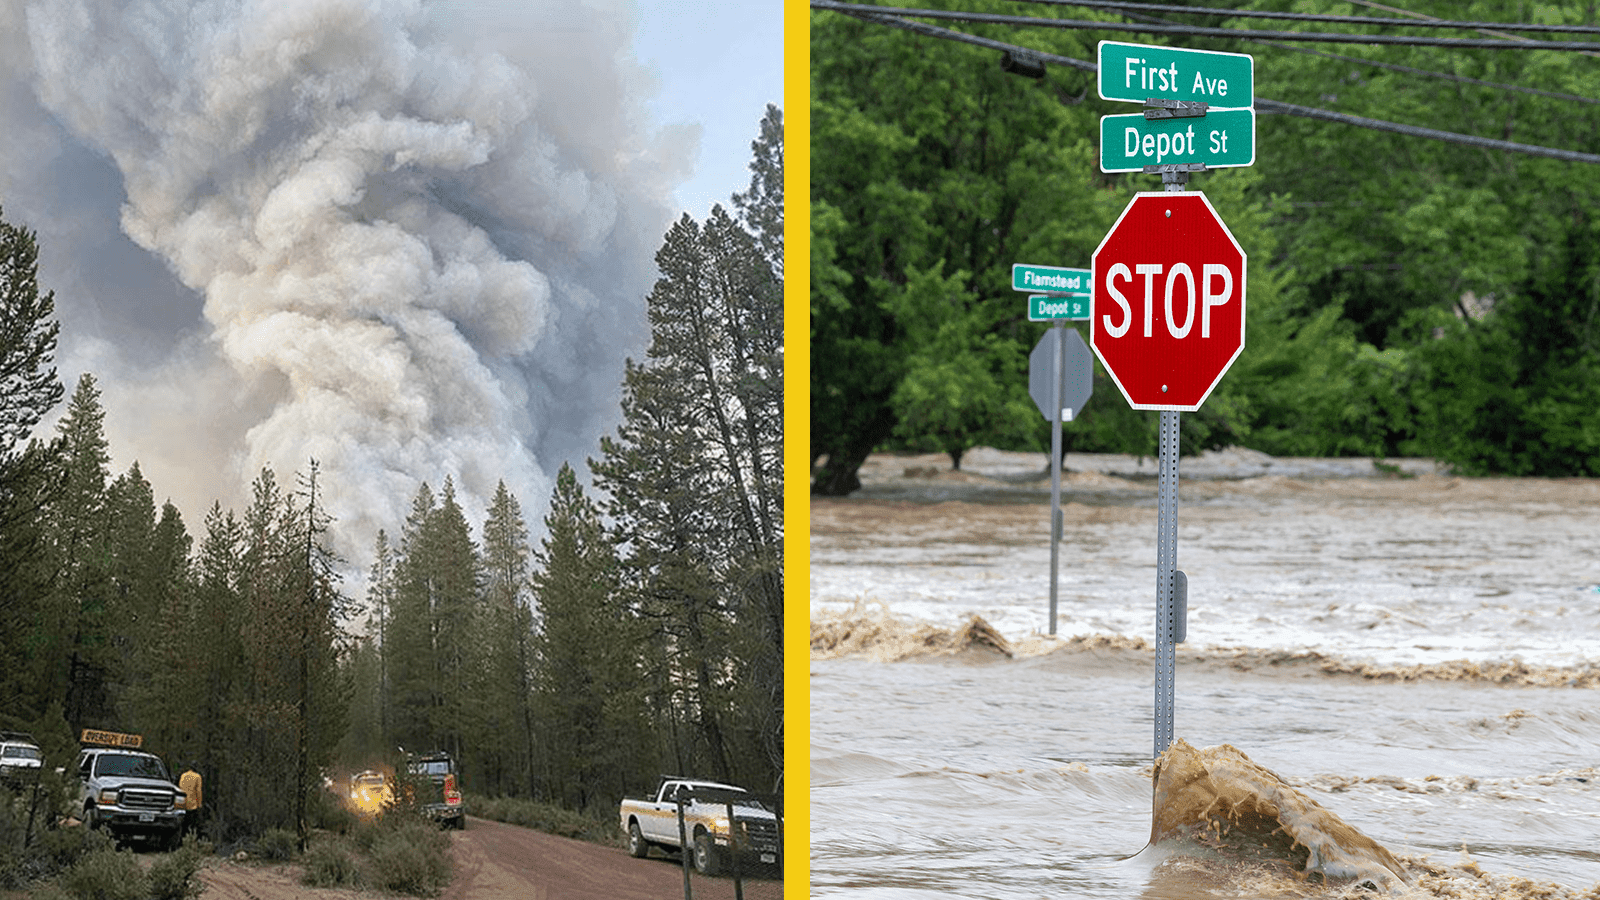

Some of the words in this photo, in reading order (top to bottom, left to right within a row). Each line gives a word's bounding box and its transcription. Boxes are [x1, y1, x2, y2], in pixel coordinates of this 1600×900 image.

[1125, 57, 1178, 92] First
[1192, 71, 1228, 96] Ave
[1125, 124, 1195, 163] Depot
[1209, 129, 1228, 154] St
[1024, 270, 1081, 289] Flamstead
[1038, 300, 1068, 317] Depot
[1072, 303, 1082, 314] St
[1102, 262, 1233, 339] STOP
[121, 734, 139, 746] LOAD
